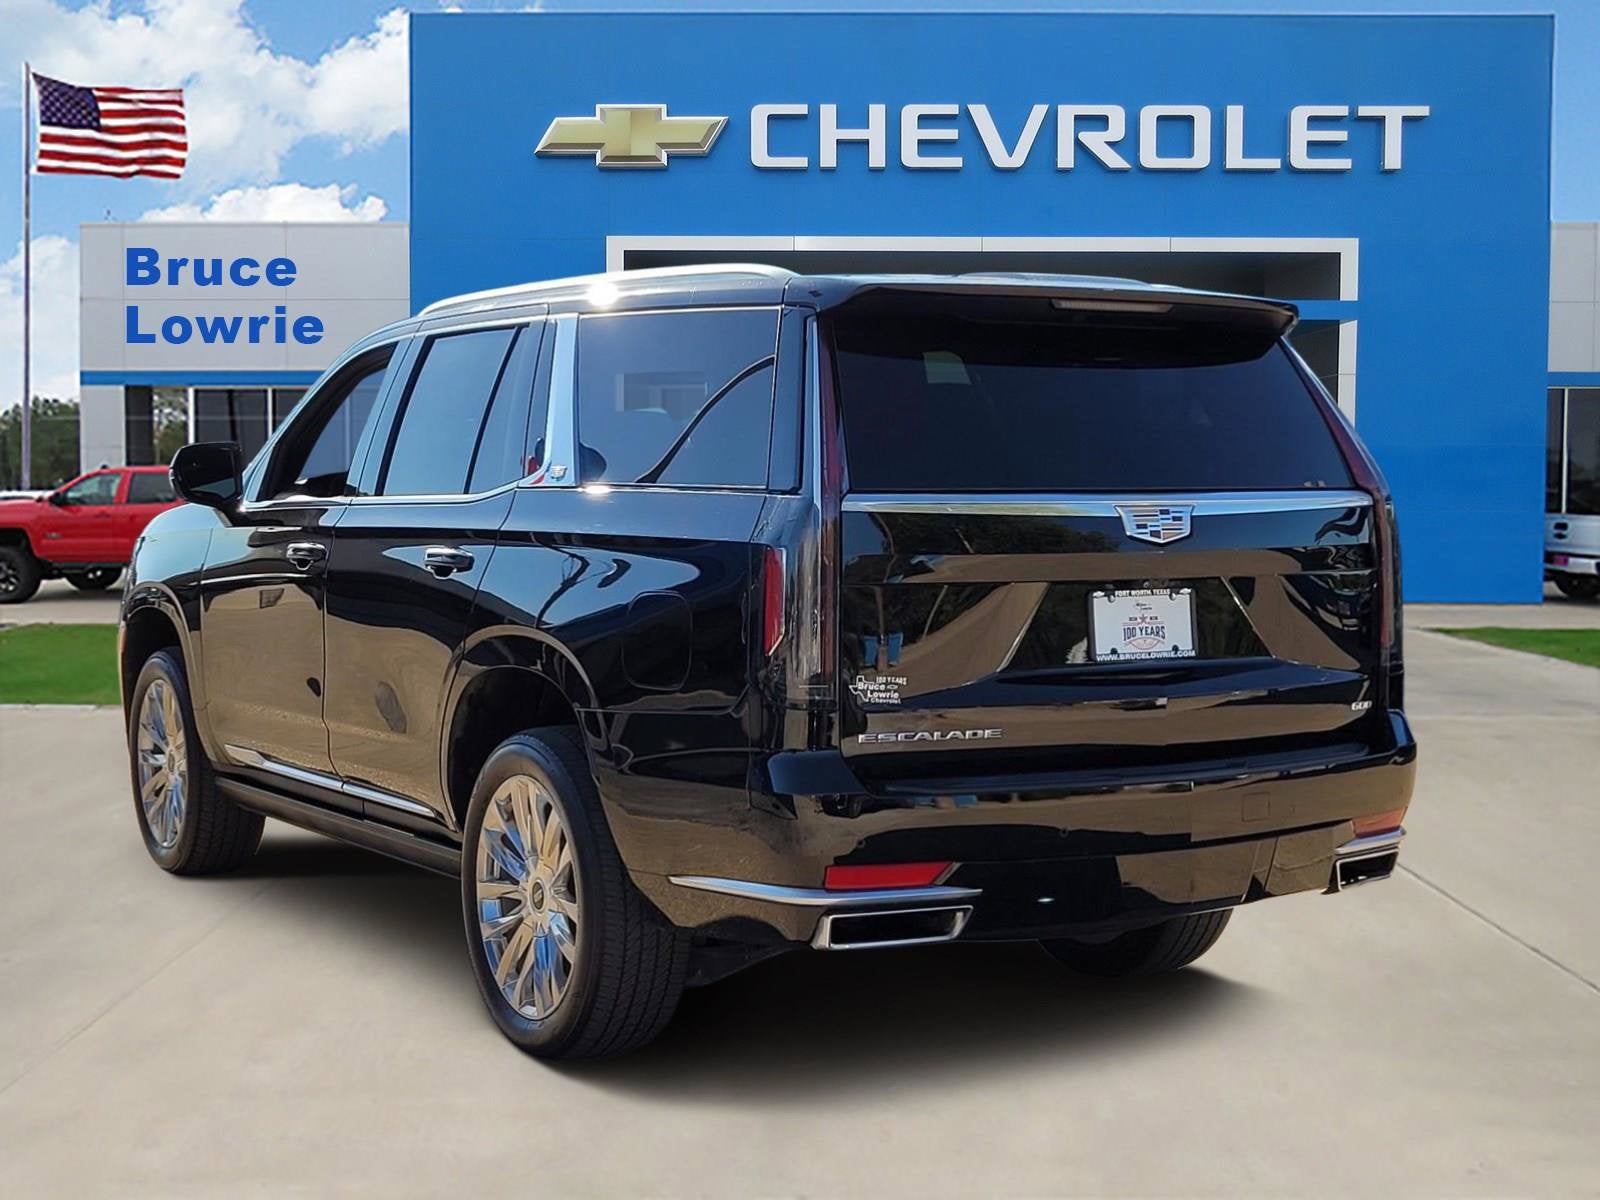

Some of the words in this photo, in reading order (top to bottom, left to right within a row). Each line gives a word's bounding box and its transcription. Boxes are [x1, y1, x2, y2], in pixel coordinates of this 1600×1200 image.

[750, 103, 1431, 172] CHEVROLET
[127, 247, 297, 287] Bruce
[127, 304, 325, 345] Lowrie
[1123, 627, 1137, 642] 100
[1138, 625, 1166, 640] YEARS
[1096, 650, 1196, 662] WWW.BRUCELOWRIE.COM
[857, 681, 886, 691] Bruce
[867, 689, 900, 699] Lowrie
[870, 697, 901, 705] Chevrolet
[858, 728, 1003, 744] ESCALADE
